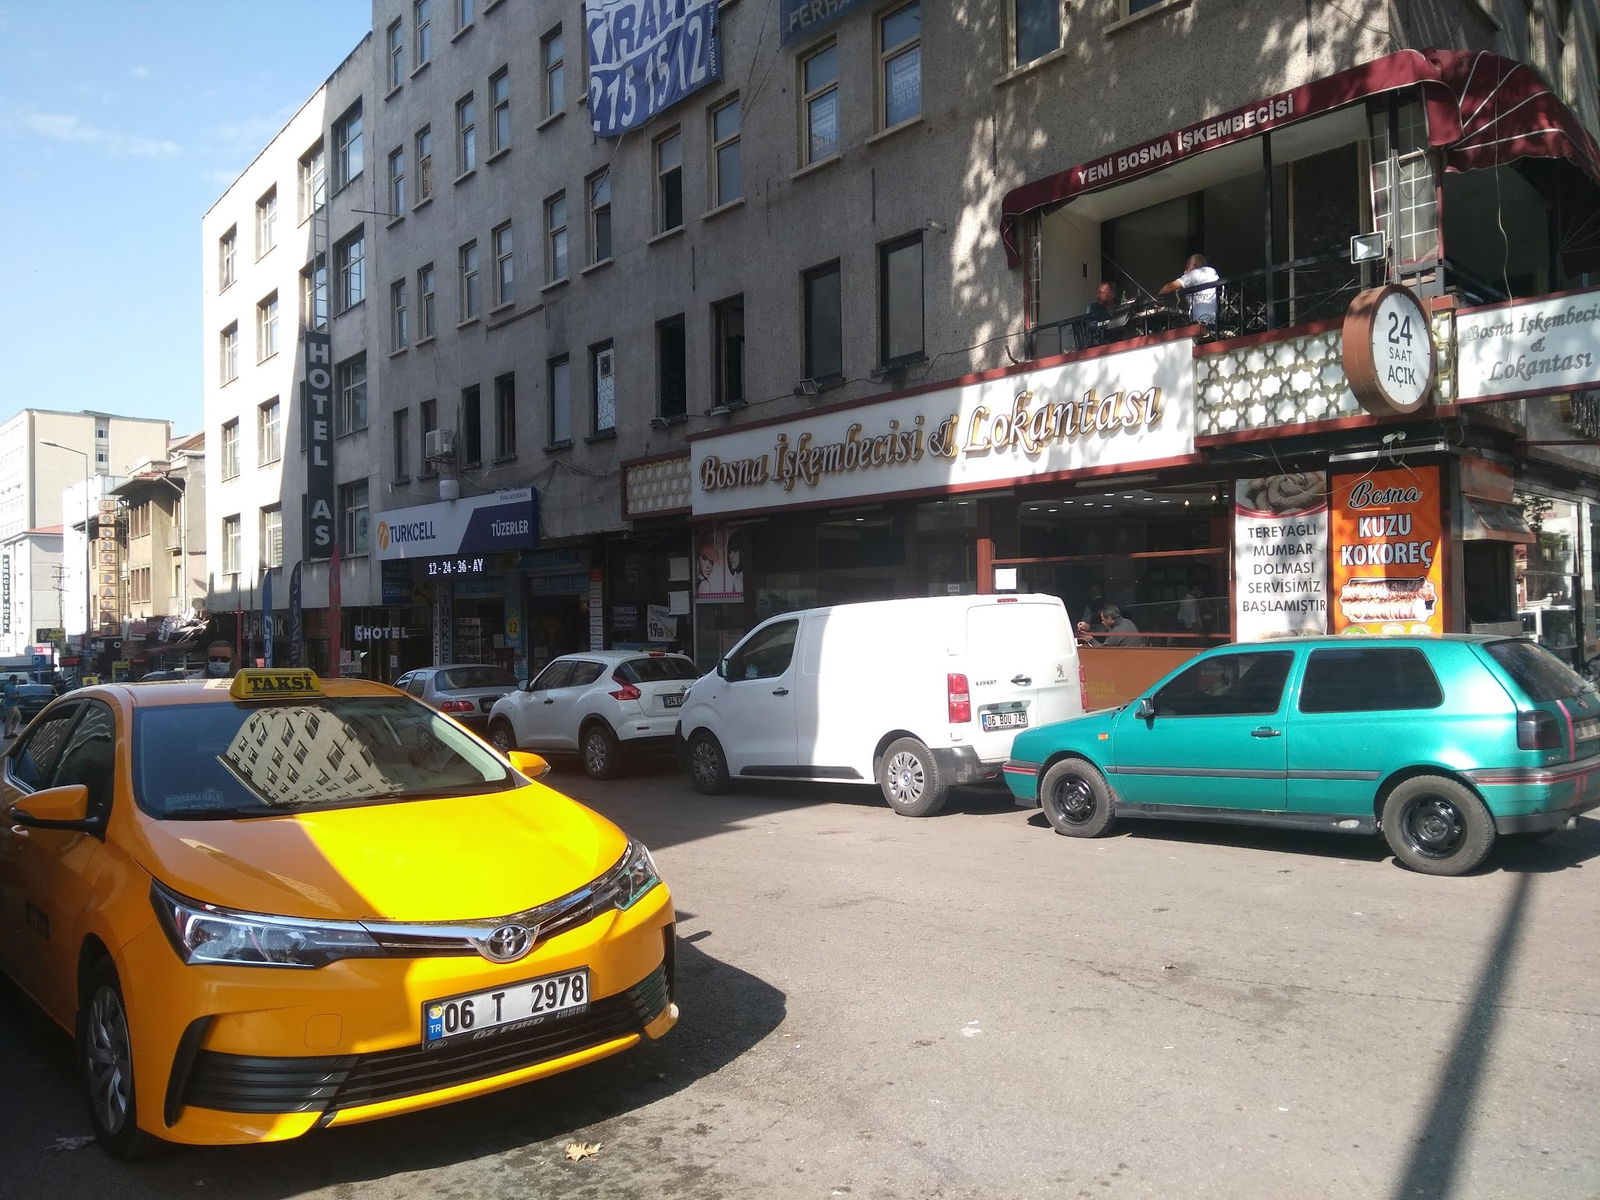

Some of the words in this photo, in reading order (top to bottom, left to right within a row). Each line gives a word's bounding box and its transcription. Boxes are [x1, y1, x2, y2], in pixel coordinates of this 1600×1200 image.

[1078, 157, 1113, 185] YENİ
[1118, 140, 1172, 172] BOSNA
[1177, 94, 1294, 152] İŞKEMBECİSİ
[1388, 311, 1413, 347] 24
[1467, 321, 1514, 341] Bosna
[1530, 336, 1546, 352] &
[1388, 348, 1413, 362] SAAT
[1487, 352, 1593, 382] Lokantası
[1387, 367, 1417, 389] AÇIK
[309, 343, 330, 467] HOTEL
[699, 454, 768, 492] Bosna
[770, 415, 925, 491] İşkembecisi
[926, 414, 959, 458] &
[962, 386, 1163, 460] Lokantası
[1348, 480, 1423, 509] Bosna
[311, 500, 332, 546] AS
[389, 519, 436, 545] TURKCELL
[491, 518, 529, 537] TÜZERLER
[1248, 521, 1317, 539] TEREYAĞLI
[1359, 513, 1412, 538] KUZU
[1253, 543, 1313, 557] MUMBAR
[1341, 541, 1433, 569] KOKOREÇ
[1253, 562, 1315, 576] DOLMASI
[1247, 578, 1321, 594] SERVİSİMİZ
[102, 574, 113, 634] PALA
[1242, 599, 1326, 615] BAŞLAMIŞTIR
[253, 616, 286, 636] PİİK
[363, 626, 410, 640] HOTEL
[247, 672, 313, 692] TAKSİ
[987, 714, 997, 727] 06
[1014, 712, 1026, 725] 749
[430, 1024, 441, 1034] TR
[444, 1000, 475, 1033] 06
[492, 992, 505, 1022] T
[531, 975, 584, 1014] 2978
[501, 1016, 545, 1033] FORD
